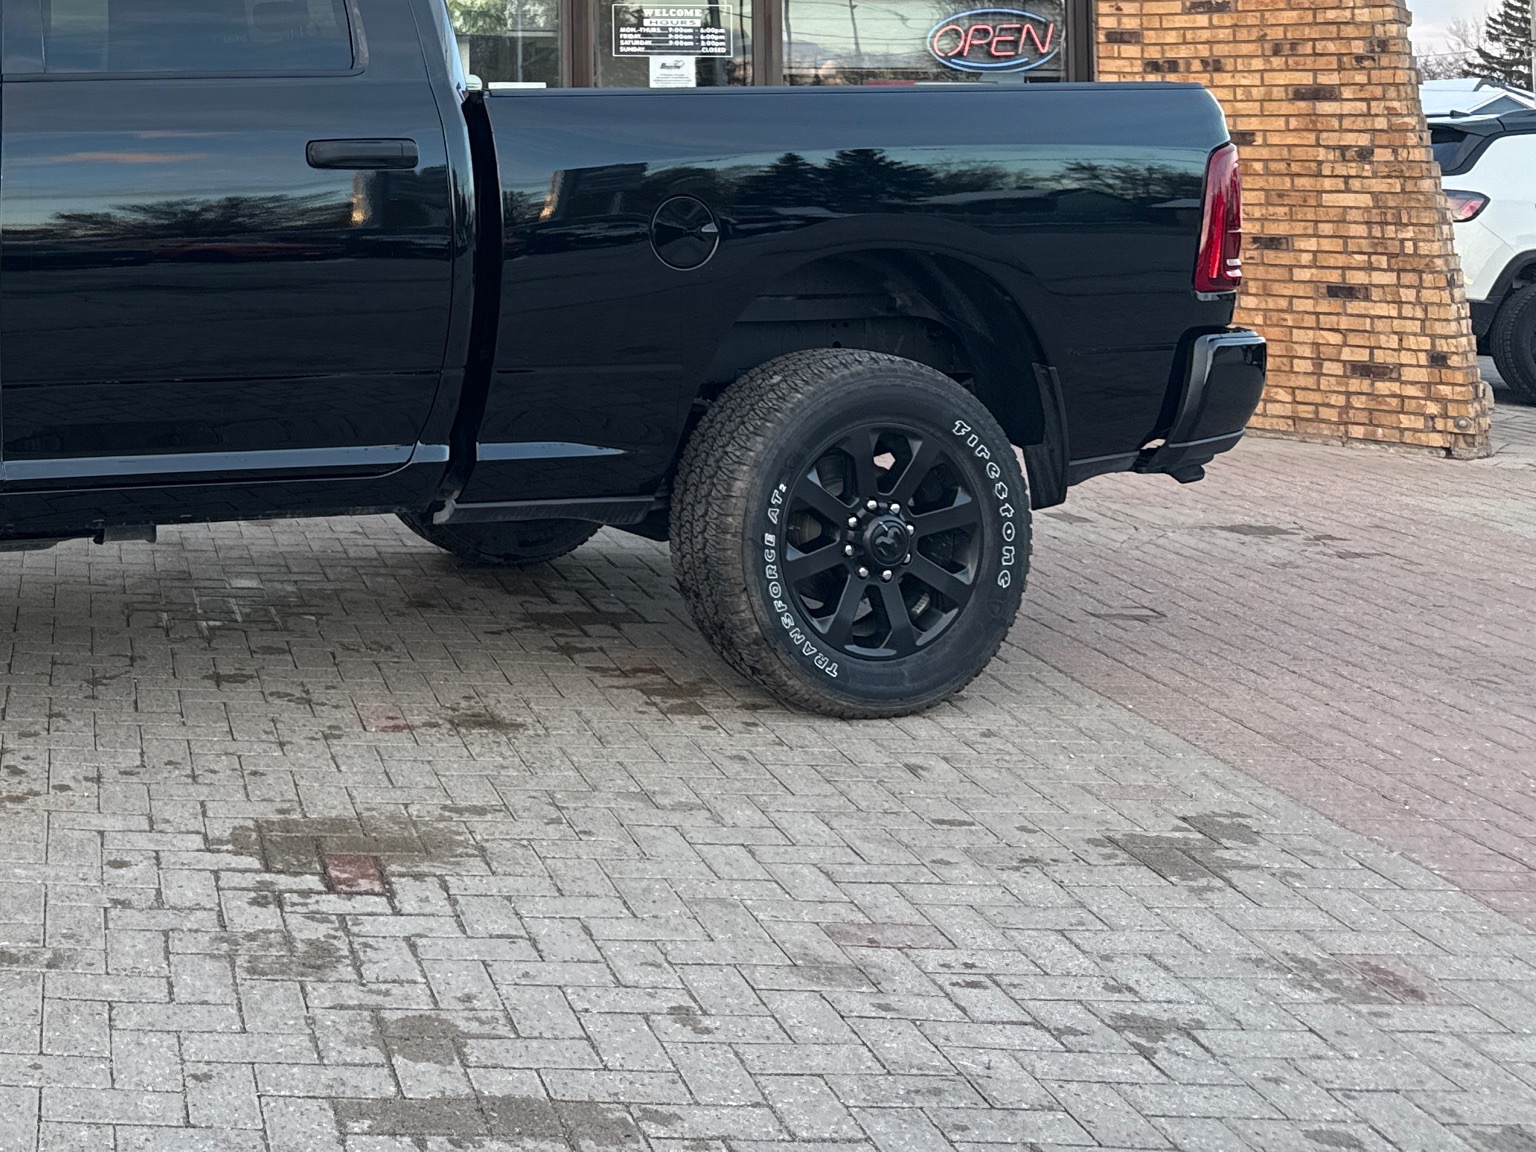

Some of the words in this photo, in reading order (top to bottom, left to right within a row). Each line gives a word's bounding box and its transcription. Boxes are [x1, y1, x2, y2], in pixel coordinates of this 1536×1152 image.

[643, 8, 703, 17] WELCOME
[933, 22, 1054, 57] OPEN
[952, 419, 1015, 588] Firestone
[764, 532, 839, 678] TRANSFORCE
